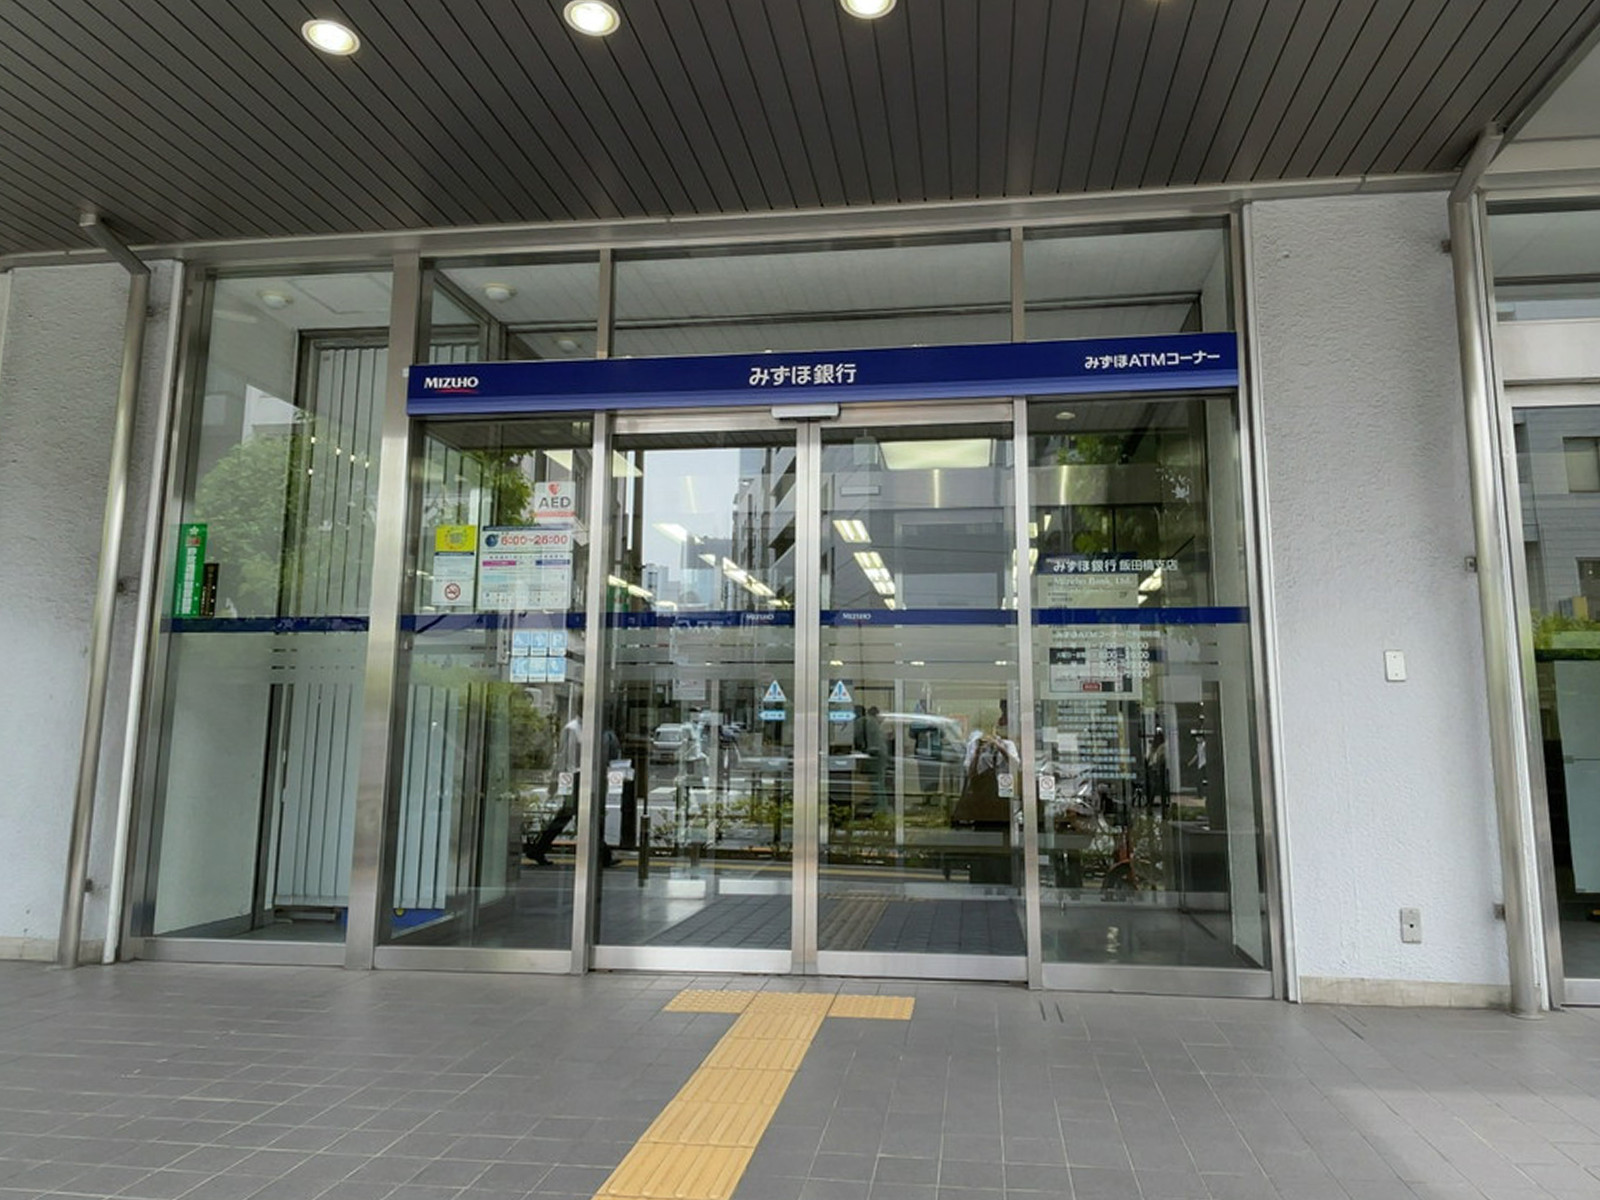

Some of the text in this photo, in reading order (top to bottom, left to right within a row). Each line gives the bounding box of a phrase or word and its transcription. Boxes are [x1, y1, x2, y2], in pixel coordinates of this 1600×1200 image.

[1084, 350, 1220, 369] みずほATMコーナー
[749, 363, 857, 386] みずほ銀行
[424, 377, 479, 389] MIZUHO
[538, 496, 571, 508] AED
[1053, 559, 1117, 572] みずほ銀行
